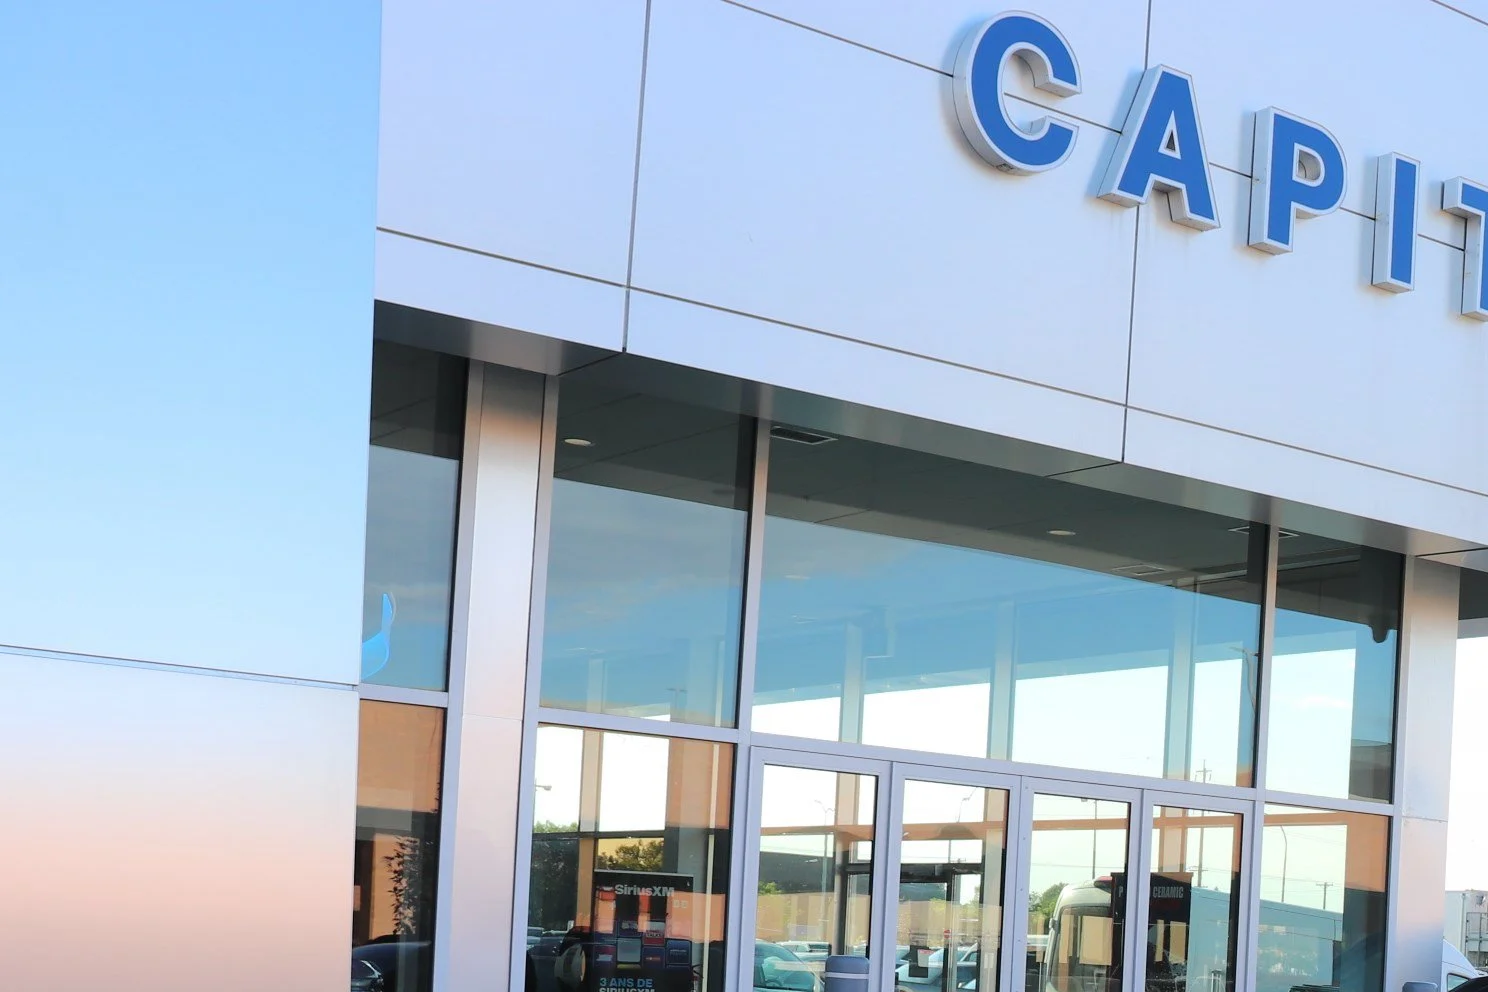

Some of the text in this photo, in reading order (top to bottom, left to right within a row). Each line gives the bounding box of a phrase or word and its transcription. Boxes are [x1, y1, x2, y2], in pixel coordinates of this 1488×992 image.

[614, 884, 674, 897] SiriusXM
[1152, 886, 1184, 898] CERAMIC
[600, 977, 653, 988] 3 ANS DE
